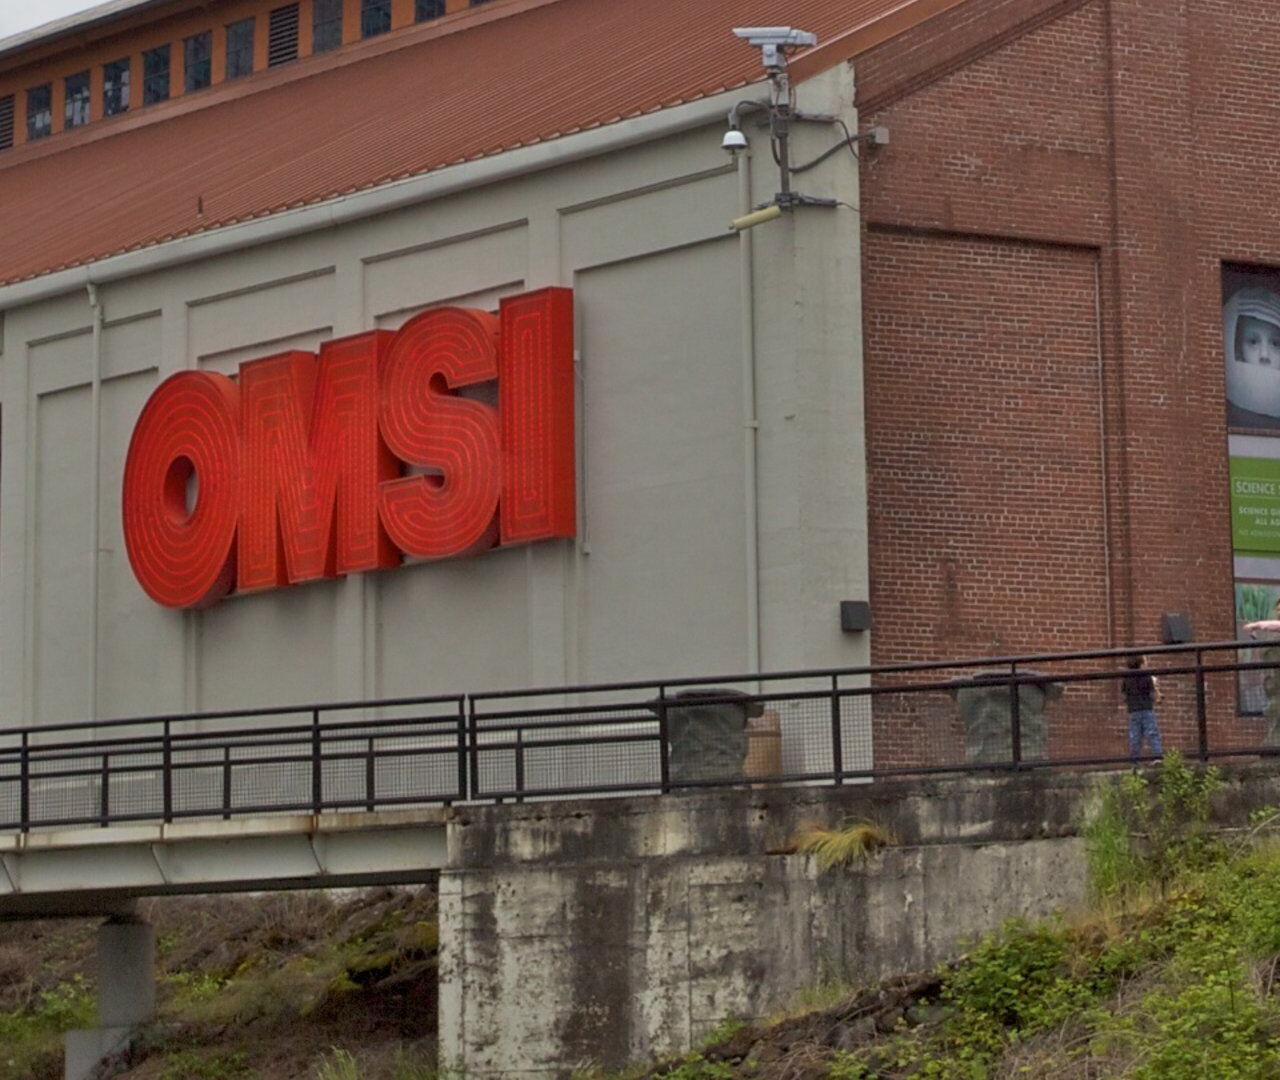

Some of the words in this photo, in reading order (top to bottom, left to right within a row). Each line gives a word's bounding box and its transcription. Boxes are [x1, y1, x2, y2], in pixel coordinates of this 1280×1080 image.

[122, 286, 577, 610] OMSI
[1236, 481, 1276, 495] SCIENCE
[1239, 506, 1268, 516] SCIENCE
[1255, 517, 1268, 526] ALL
